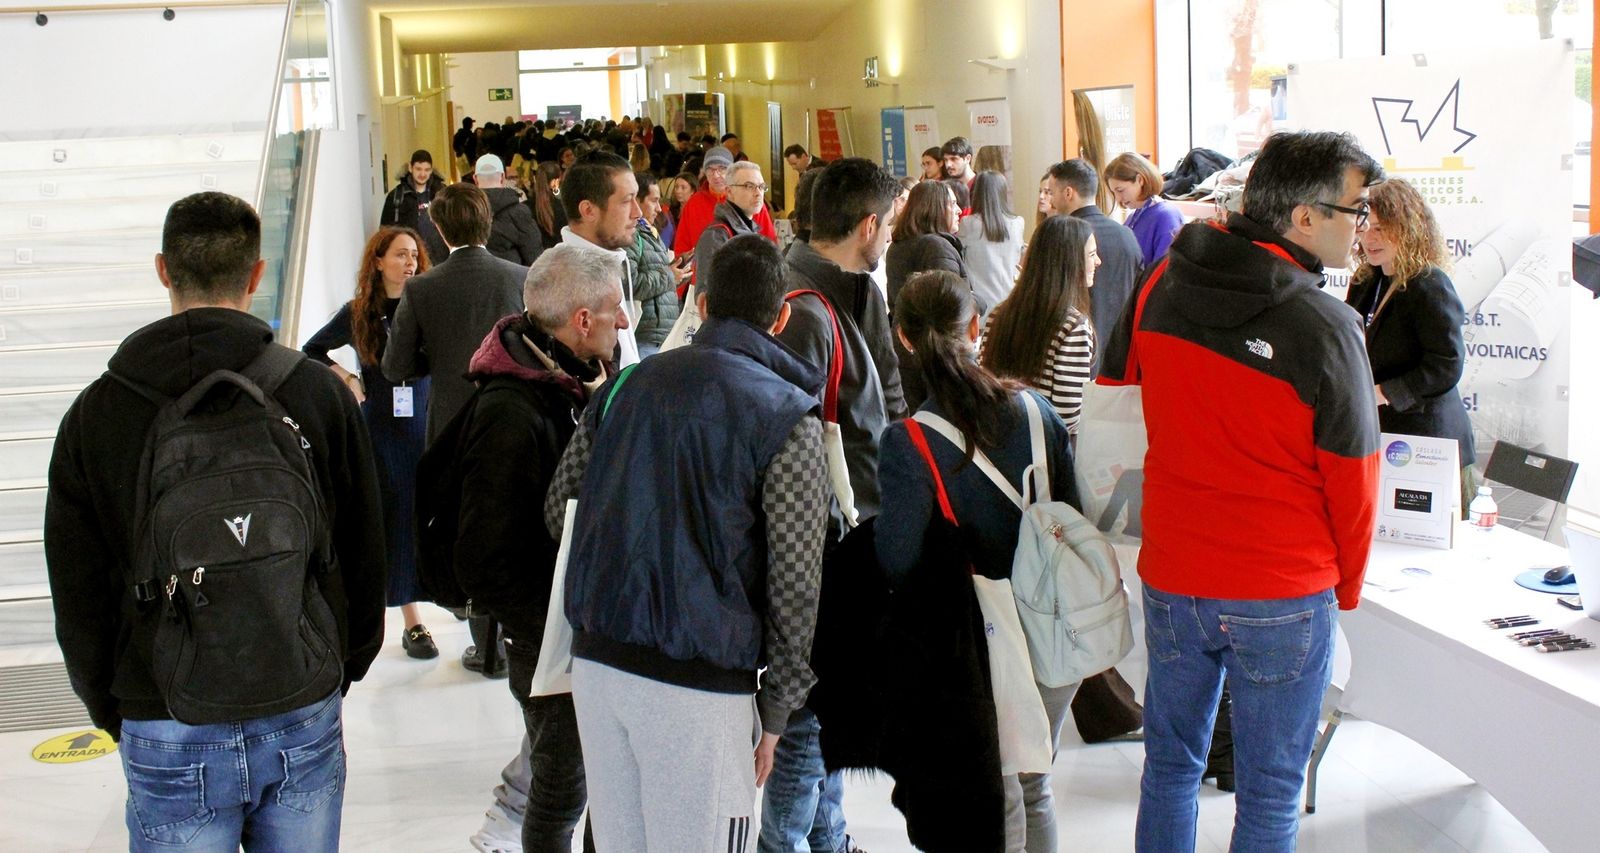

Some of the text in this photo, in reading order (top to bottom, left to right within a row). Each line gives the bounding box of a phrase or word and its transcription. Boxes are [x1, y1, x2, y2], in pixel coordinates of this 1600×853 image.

[1410, 176, 1464, 186] ACENES
[1419, 186, 1464, 195] RICOS
[1456, 195, 1484, 205] S.A.
[1445, 238, 1473, 257] EN:
[1329, 273, 1350, 288] ILU
[1475, 312, 1501, 327] B.T.
[1465, 343, 1548, 361] VOLTAICAS
[1462, 392, 1478, 411] s!
[38, 748, 106, 760] ENTRADA
